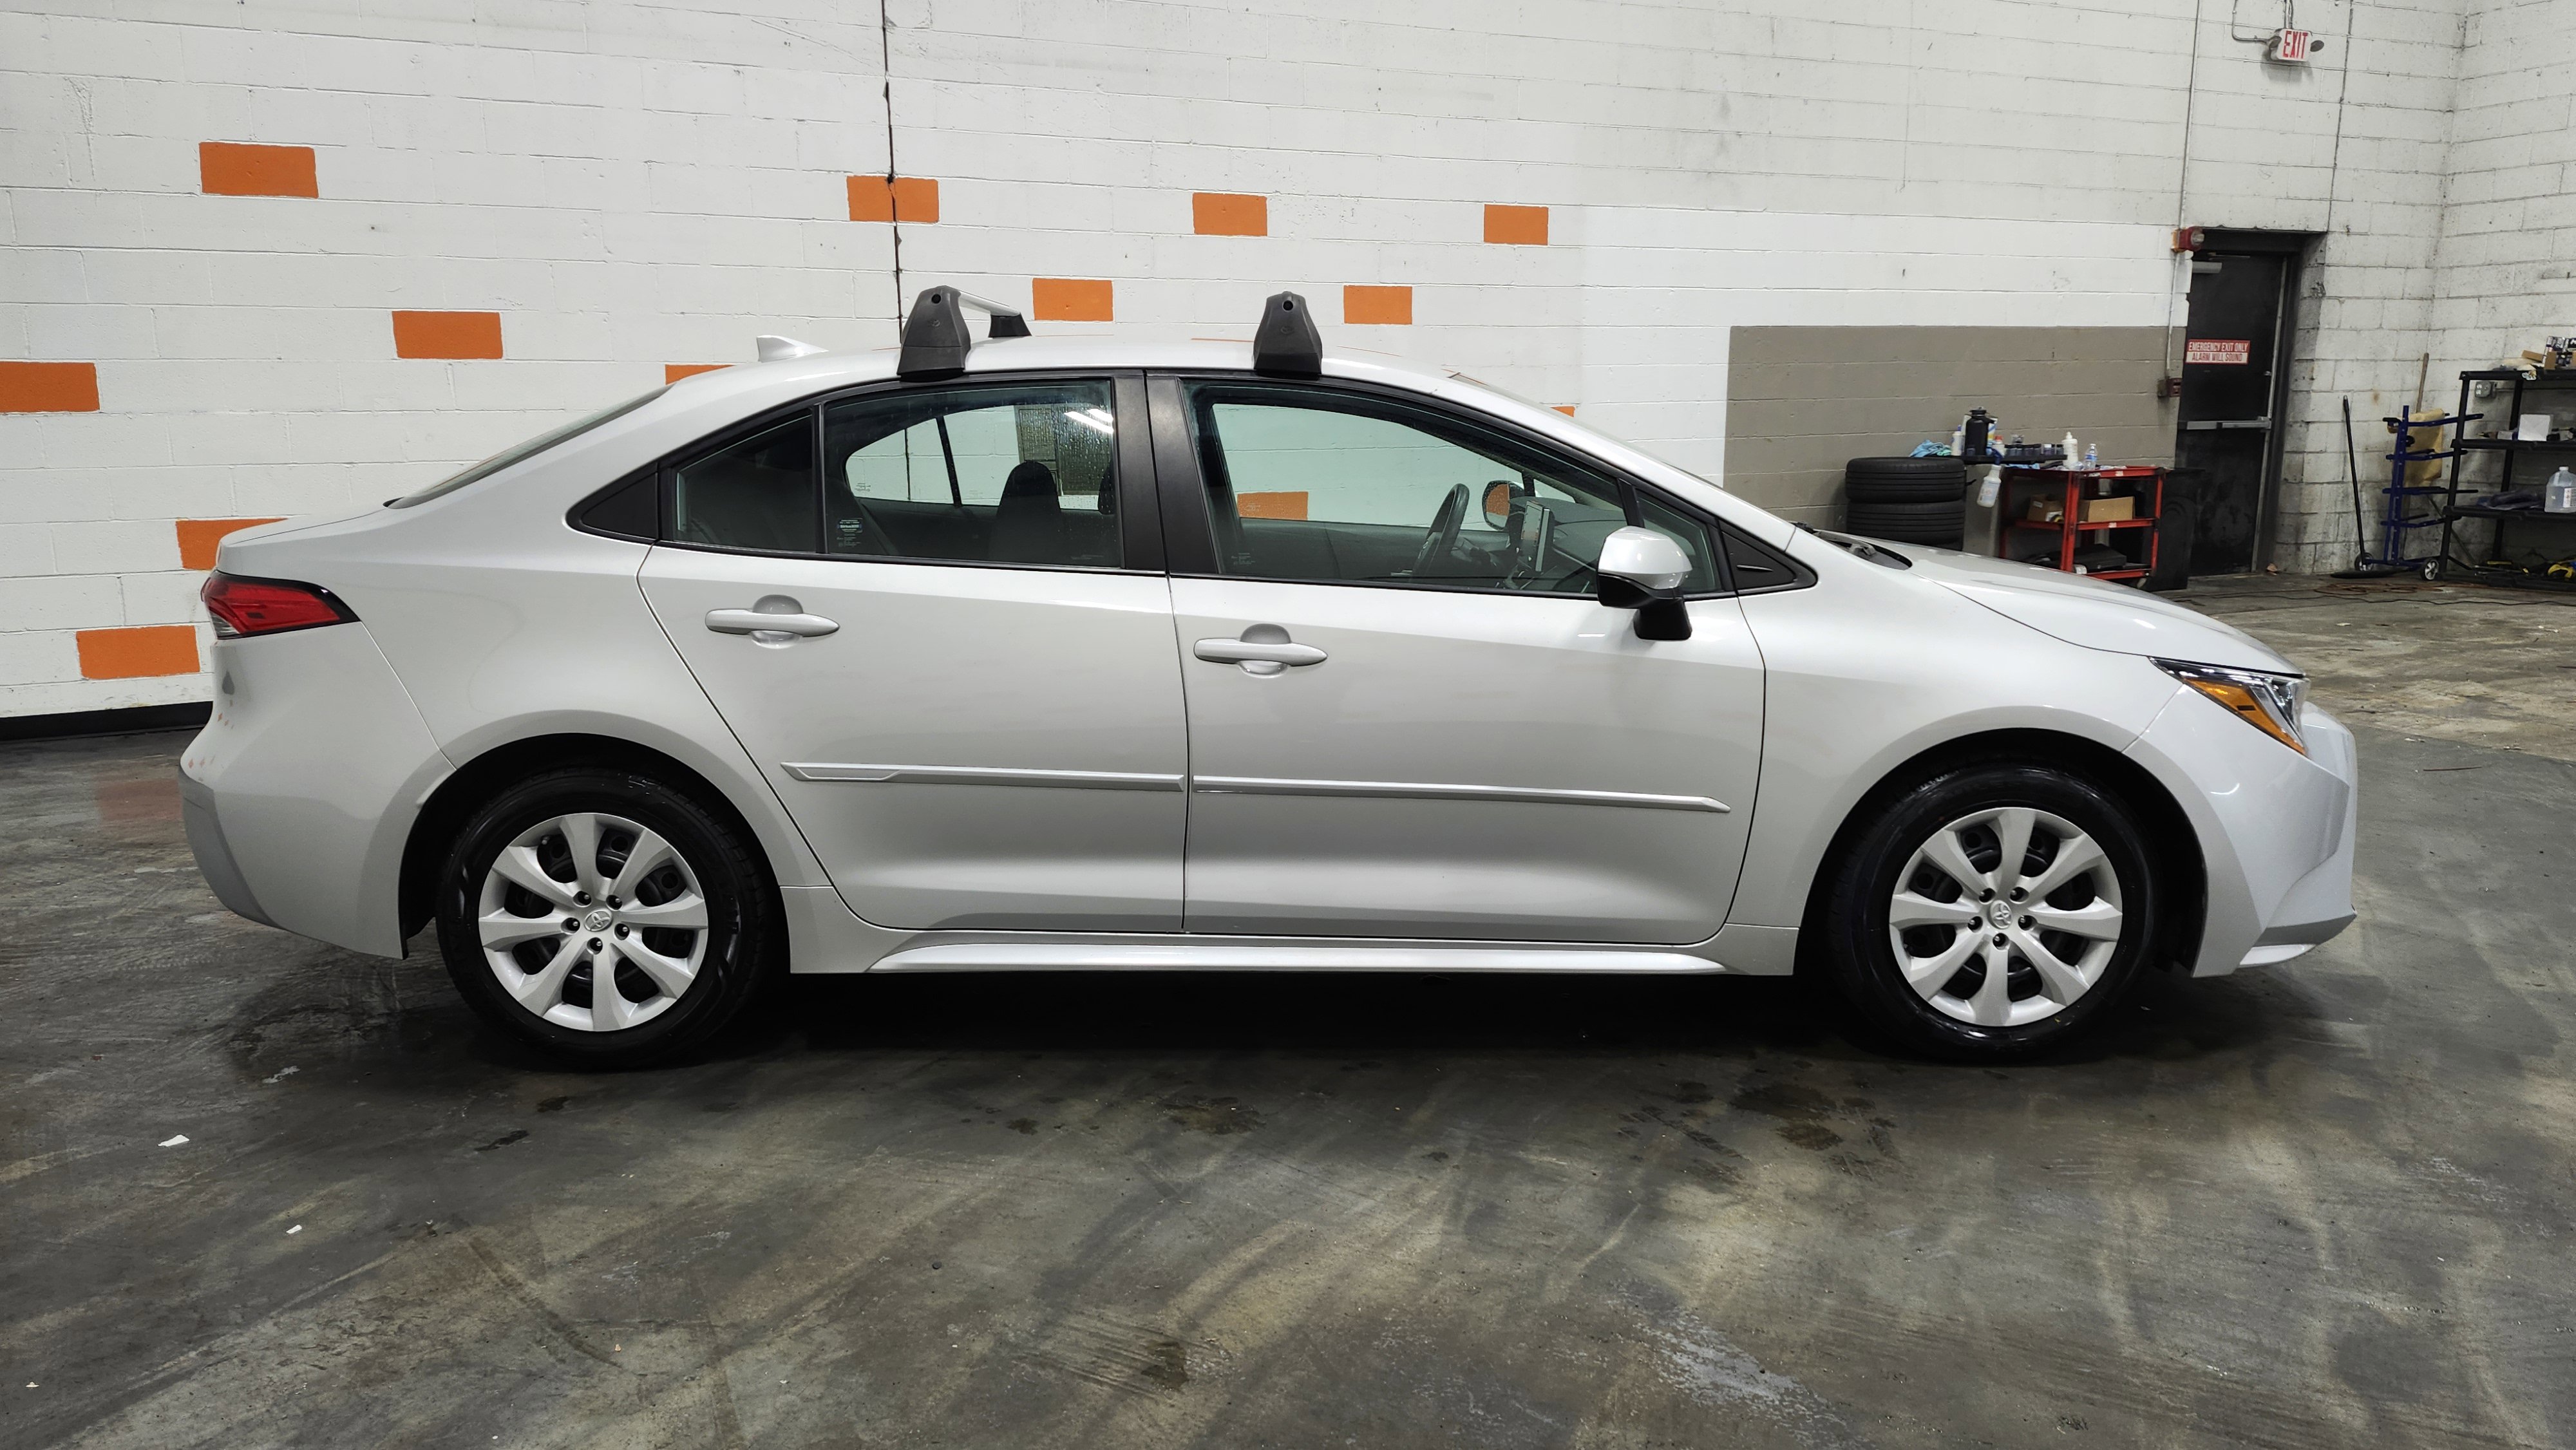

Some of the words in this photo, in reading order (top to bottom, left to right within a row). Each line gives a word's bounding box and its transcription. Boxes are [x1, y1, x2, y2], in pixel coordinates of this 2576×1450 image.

[2283, 30, 2308, 59] EXIT
[2189, 342, 2221, 352] EMERGENCY
[2221, 343, 2234, 352] EXIT
[2235, 343, 2248, 352] ONLY
[2192, 352, 2211, 361] ALARM
[2212, 353, 2223, 361] WILL
[2225, 353, 2242, 362] SOUND
